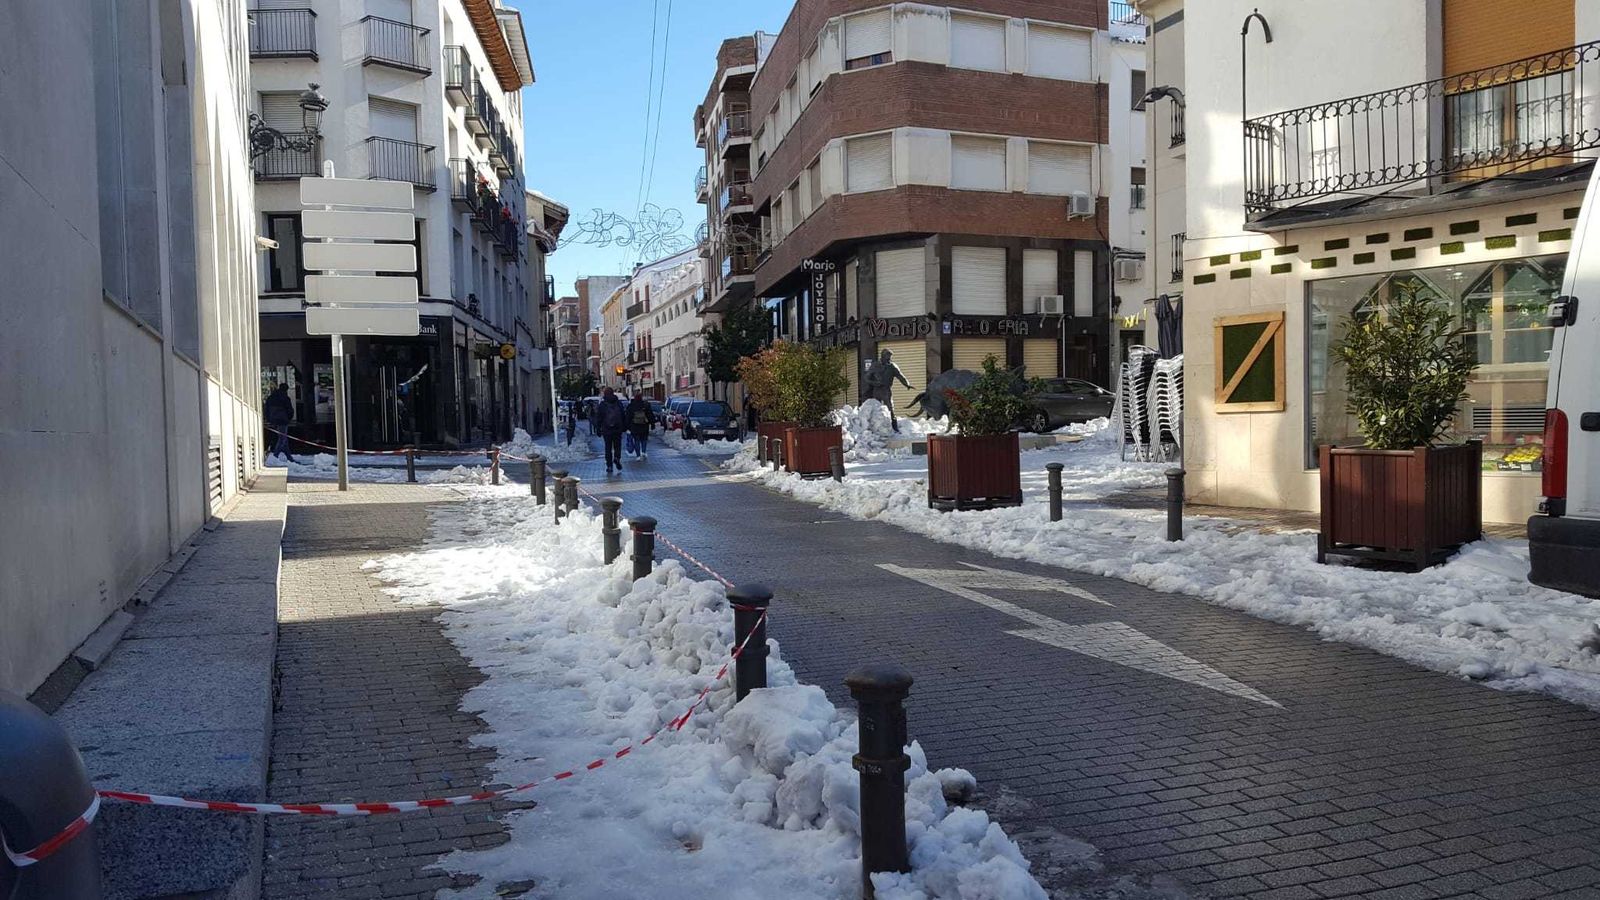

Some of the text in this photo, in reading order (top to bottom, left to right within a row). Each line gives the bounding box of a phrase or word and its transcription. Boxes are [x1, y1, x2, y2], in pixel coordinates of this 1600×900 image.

[803, 259, 836, 272] Marjo
[815, 273, 825, 322] JOYERO
[868, 317, 931, 339] Marjo
